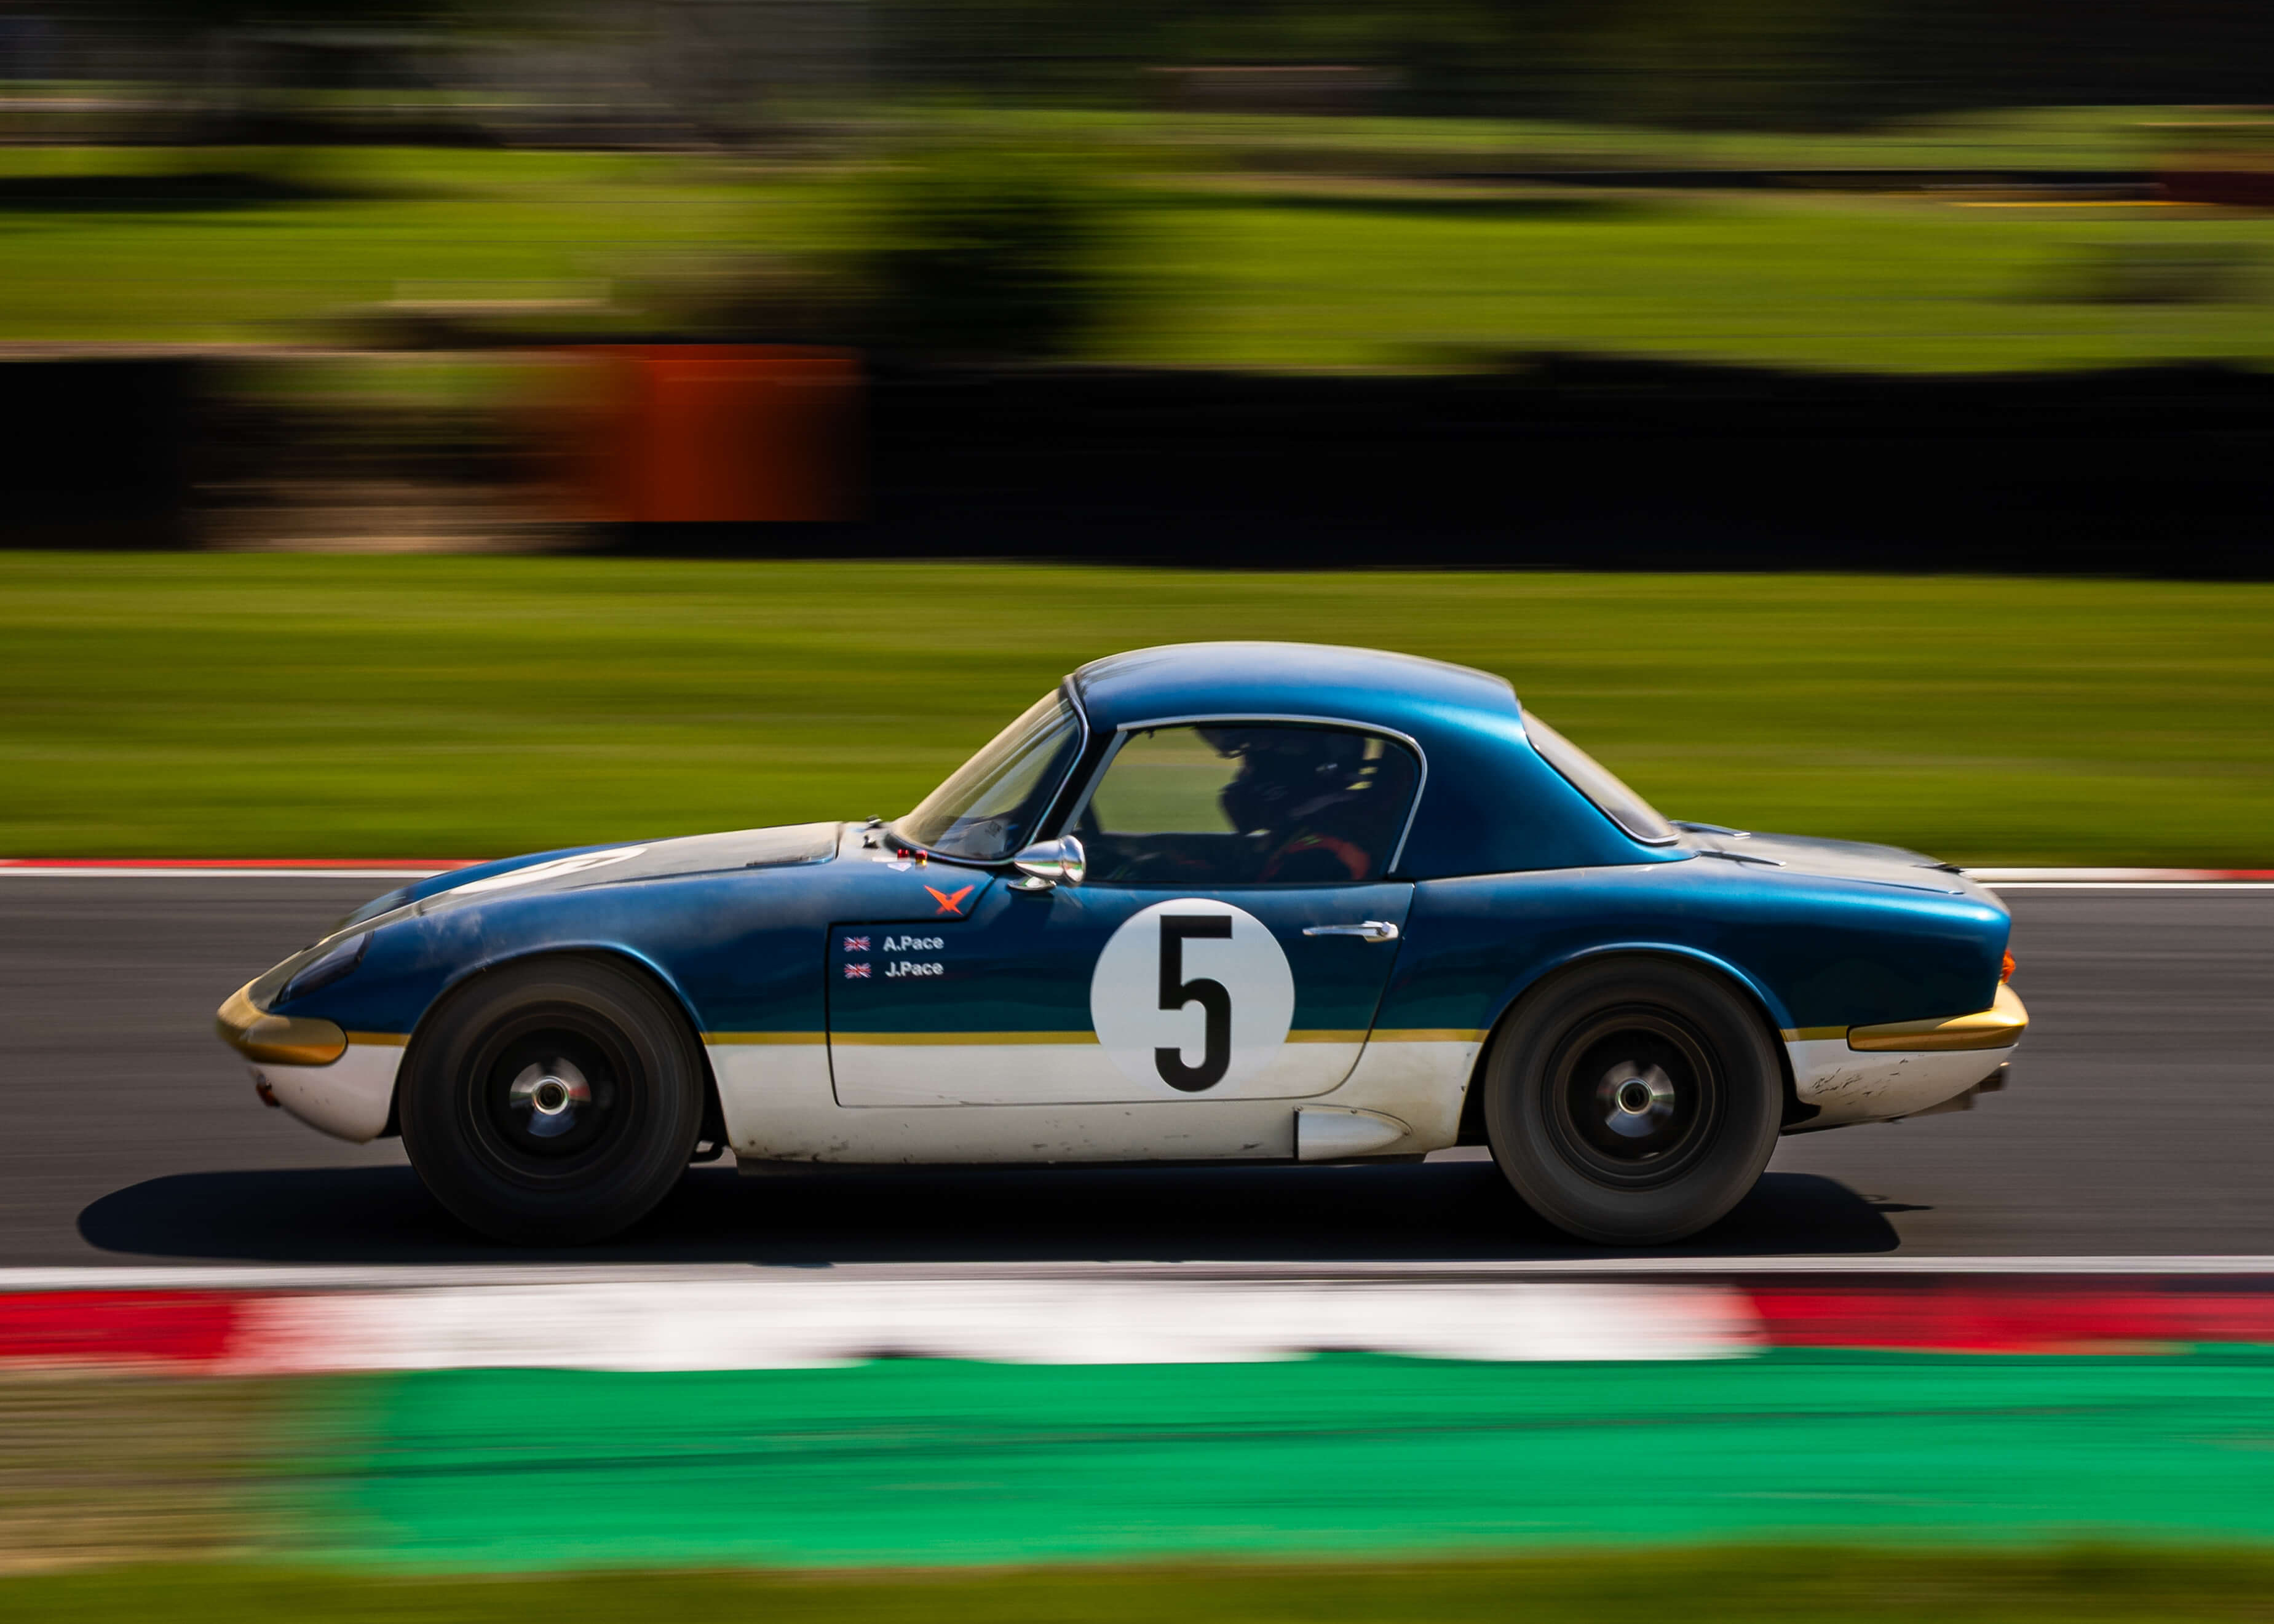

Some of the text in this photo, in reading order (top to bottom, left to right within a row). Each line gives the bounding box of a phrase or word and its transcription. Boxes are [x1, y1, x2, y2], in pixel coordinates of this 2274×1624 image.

[883, 935, 944, 951] A.Pace
[885, 961, 944, 976] J.Pace
[1155, 914, 1232, 1092] 5
